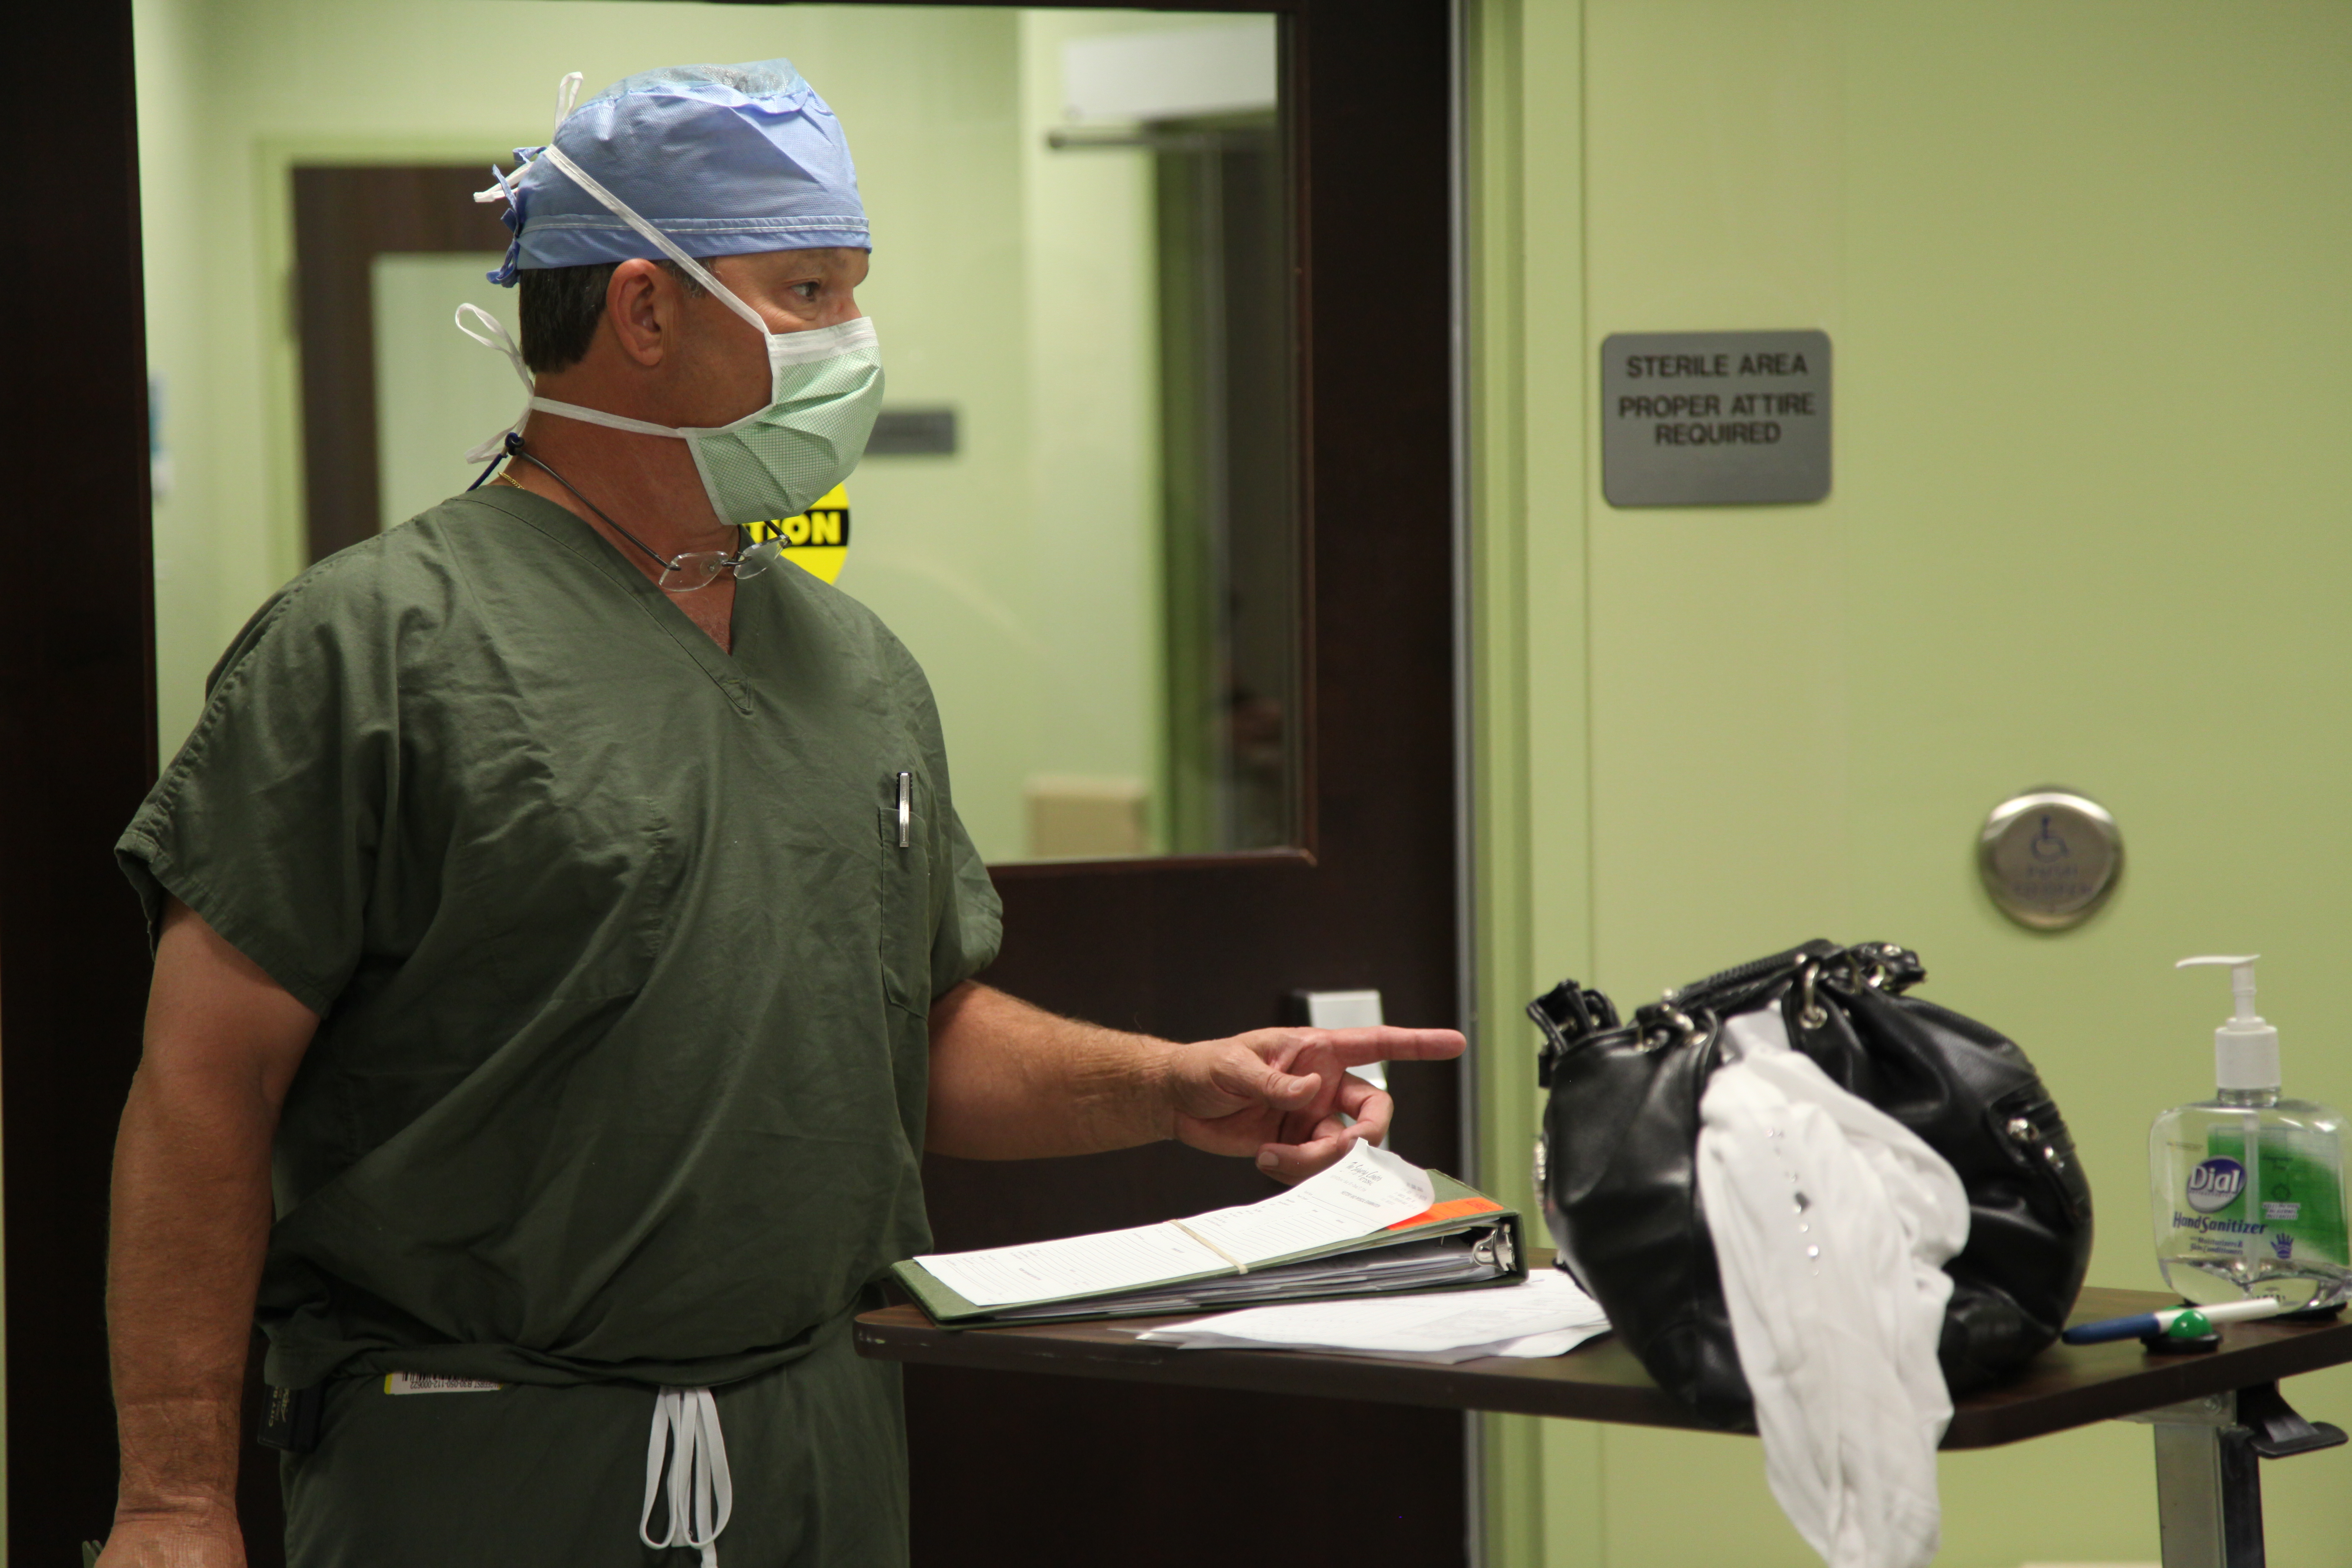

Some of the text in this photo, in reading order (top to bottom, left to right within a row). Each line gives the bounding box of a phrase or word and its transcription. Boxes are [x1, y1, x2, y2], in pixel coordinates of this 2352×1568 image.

[1626, 353, 1808, 378] STERILE AREA
[1618, 392, 1816, 418] PROPER ATTIRE
[1655, 422, 1782, 445] REQUIRED
[2190, 1166, 2241, 1193] Dial
